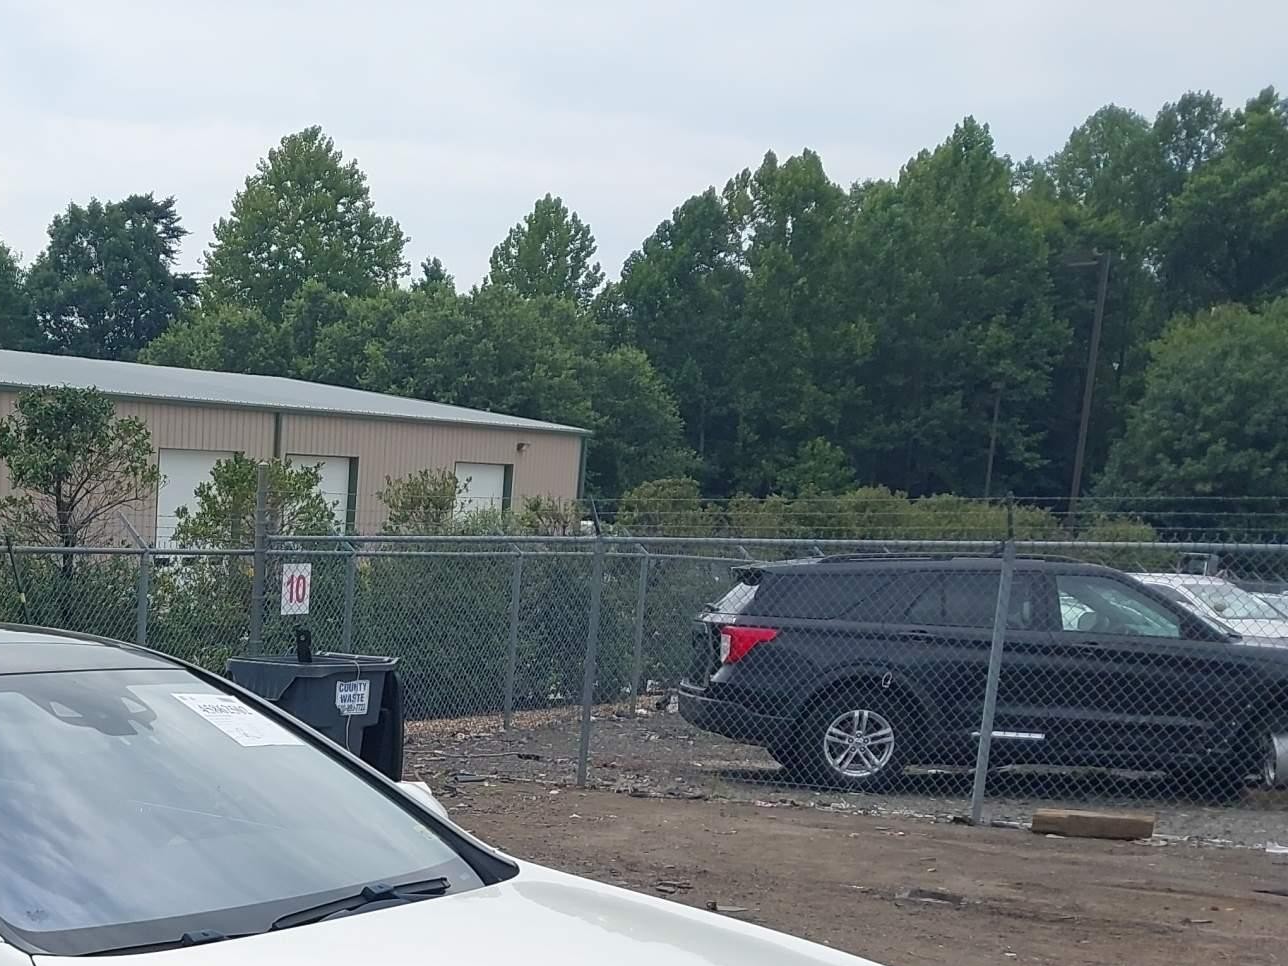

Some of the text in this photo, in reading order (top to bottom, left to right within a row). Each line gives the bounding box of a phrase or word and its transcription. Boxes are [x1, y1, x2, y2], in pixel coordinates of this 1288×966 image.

[287, 574, 307, 603] 10
[339, 682, 367, 692] COUNTY
[340, 693, 365, 703] WASTE
